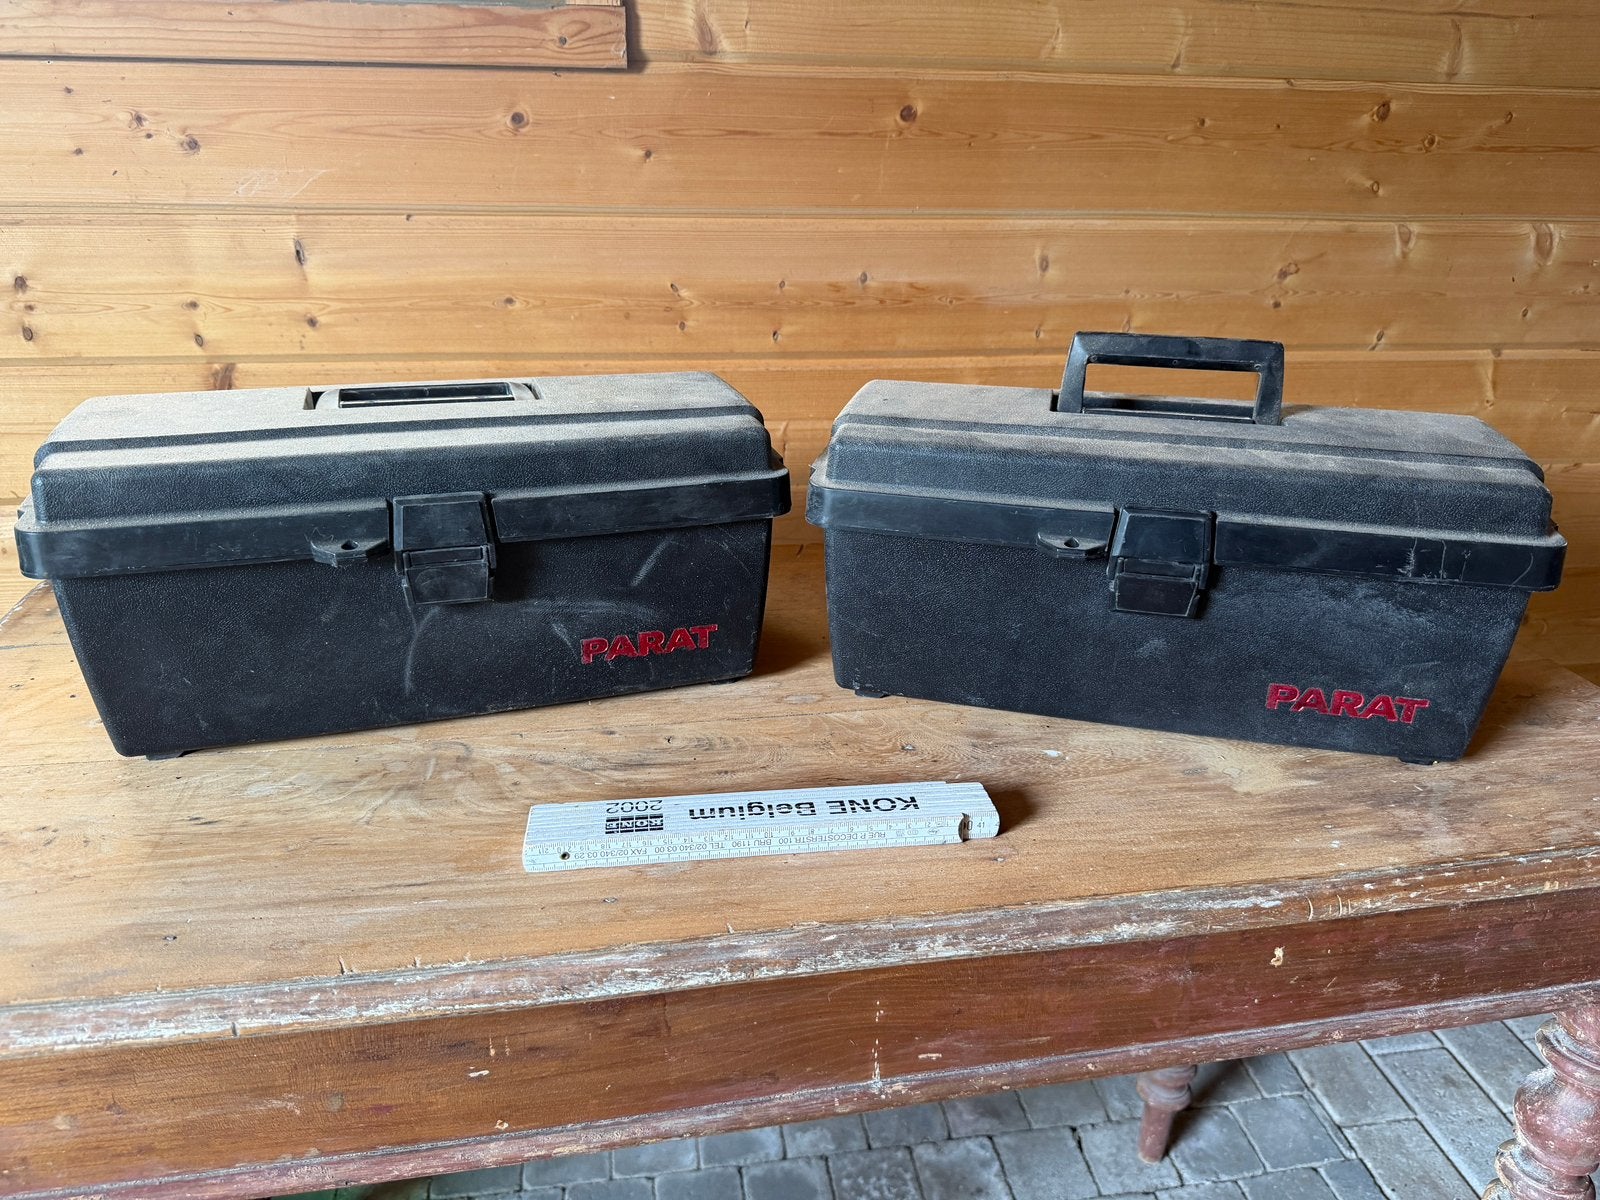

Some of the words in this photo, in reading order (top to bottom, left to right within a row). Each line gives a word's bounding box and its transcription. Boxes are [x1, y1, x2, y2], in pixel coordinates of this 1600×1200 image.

[581, 624, 718, 664] PARAT
[1265, 683, 1430, 724] PARAT
[606, 800, 663, 814] 2002
[689, 801, 817, 820] Belgium
[826, 796, 919, 814] KONE
[605, 816, 663, 831] KONE
